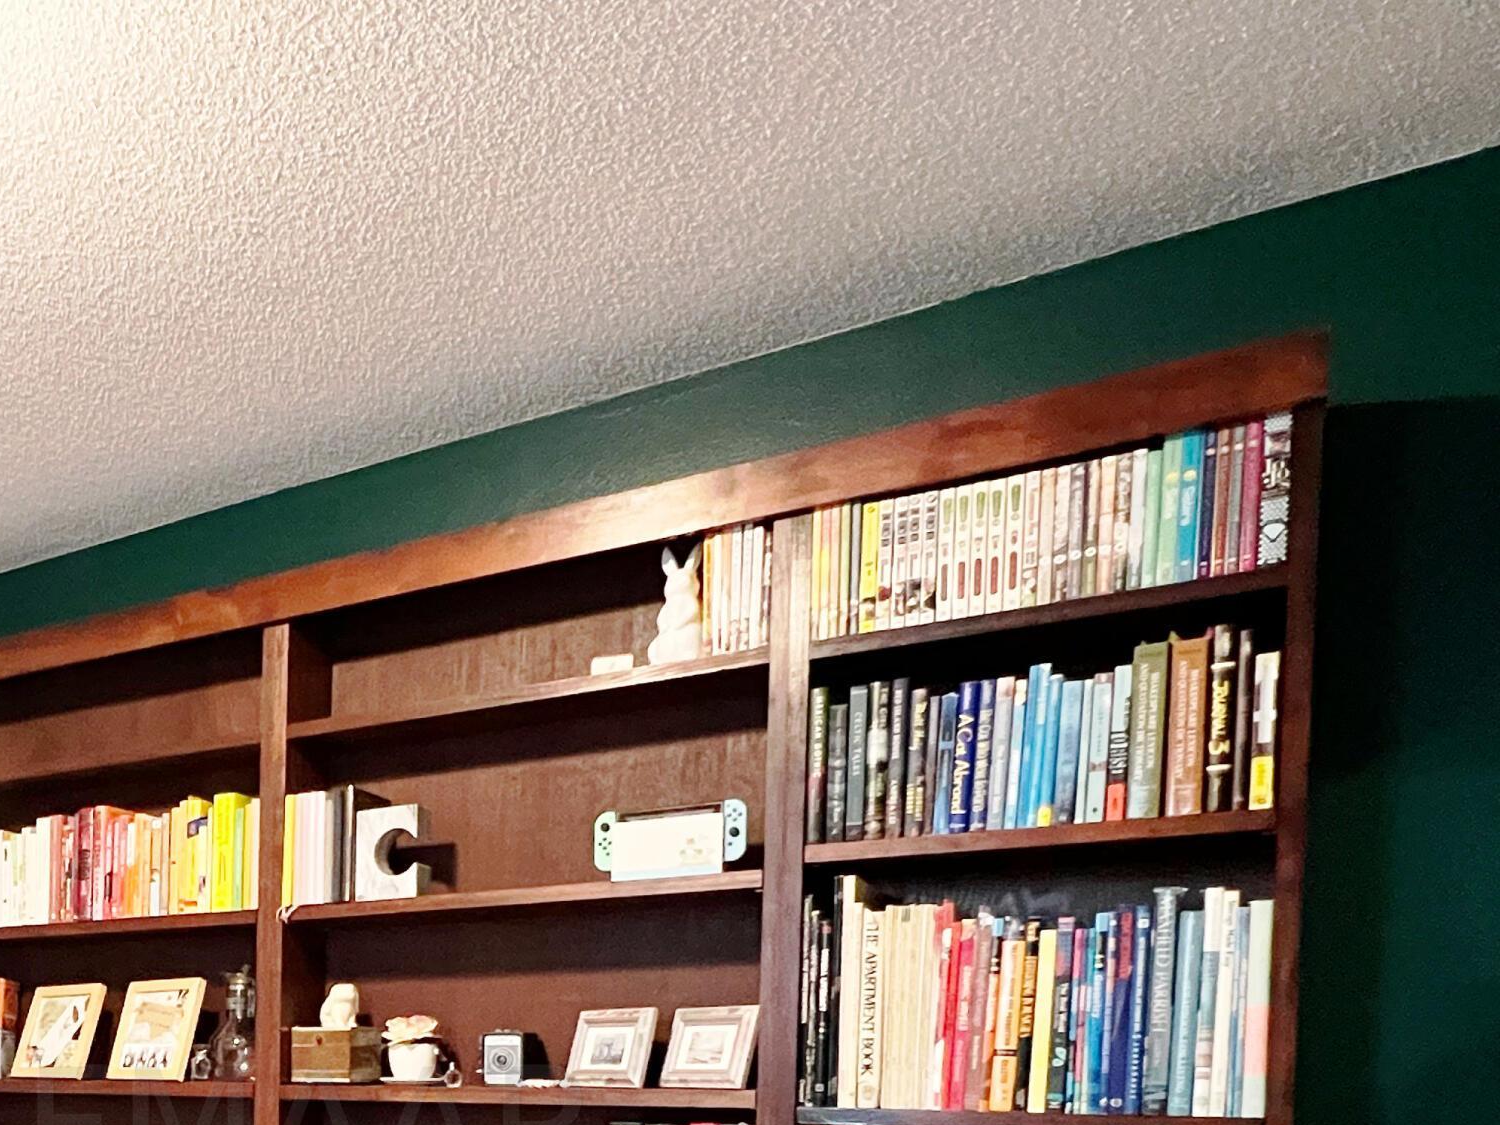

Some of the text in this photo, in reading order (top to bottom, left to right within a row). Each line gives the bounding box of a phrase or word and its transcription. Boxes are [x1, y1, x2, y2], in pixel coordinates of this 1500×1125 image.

[1208, 680, 1230, 756] JOURNAL 3
[950, 714, 974, 815] A Cat Abroad
[862, 952, 878, 1034] APARTMENT
[1151, 970, 1173, 1033] PARRISH
[860, 1038, 875, 1076] BOOK
